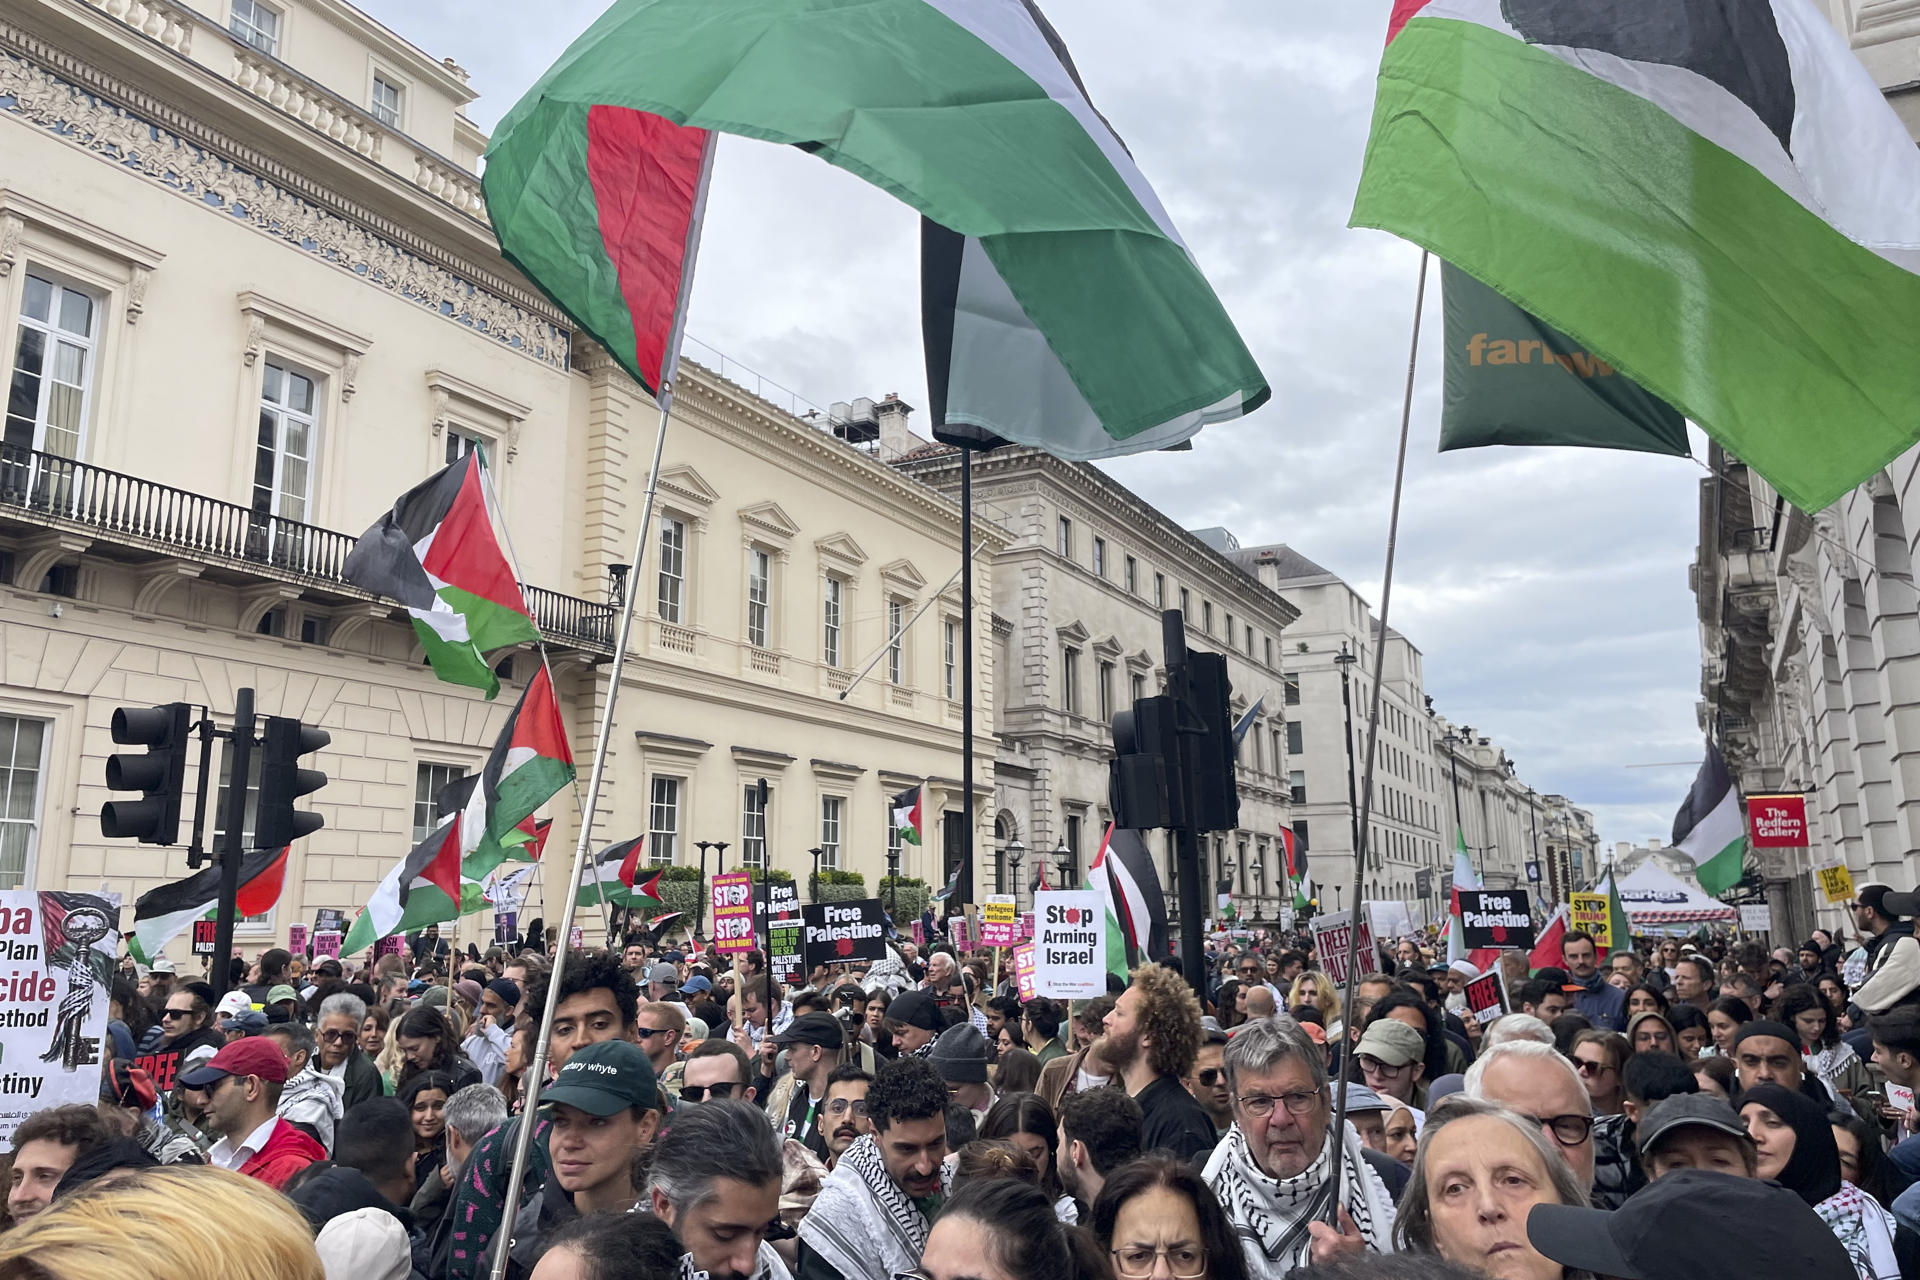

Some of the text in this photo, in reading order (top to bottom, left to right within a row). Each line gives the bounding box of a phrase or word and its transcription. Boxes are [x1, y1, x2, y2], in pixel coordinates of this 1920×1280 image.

[1765, 808, 1788, 818] The
[1756, 818, 1800, 828] Redfern
[1758, 828, 1800, 838] Gallery
[714, 884, 748, 906] STP
[770, 886, 792, 900] Free
[756, 898, 799, 914] Plestin
[1478, 894, 1511, 910] Free
[1574, 900, 1606, 911] STP
[824, 906, 862, 922] Free
[987, 905, 1013, 914] Refugees
[1463, 910, 1530, 927] Palestine
[1575, 912, 1606, 921] TRUMP
[716, 917, 751, 939] STP
[770, 928, 799, 938] FROM THE
[806, 922, 882, 943] Palestine
[985, 924, 998, 932] Stop
[1576, 922, 1607, 934] STP
[770, 937, 797, 946] RIVER TO
[994, 933, 1009, 941] right
[1043, 929, 1096, 947] Arming
[1317, 922, 1372, 958] FREEDM
[771, 946, 794, 955] THE SEA
[1046, 948, 1093, 964] Israel
[771, 954, 802, 965] PALESTINE
[772, 964, 795, 974] WILL BE
[1323, 948, 1375, 984] PALEINE
[1467, 976, 1498, 1013] FREE
[588, 1063, 617, 1074] whyte
[0, 1072, 43, 1098] tiny
